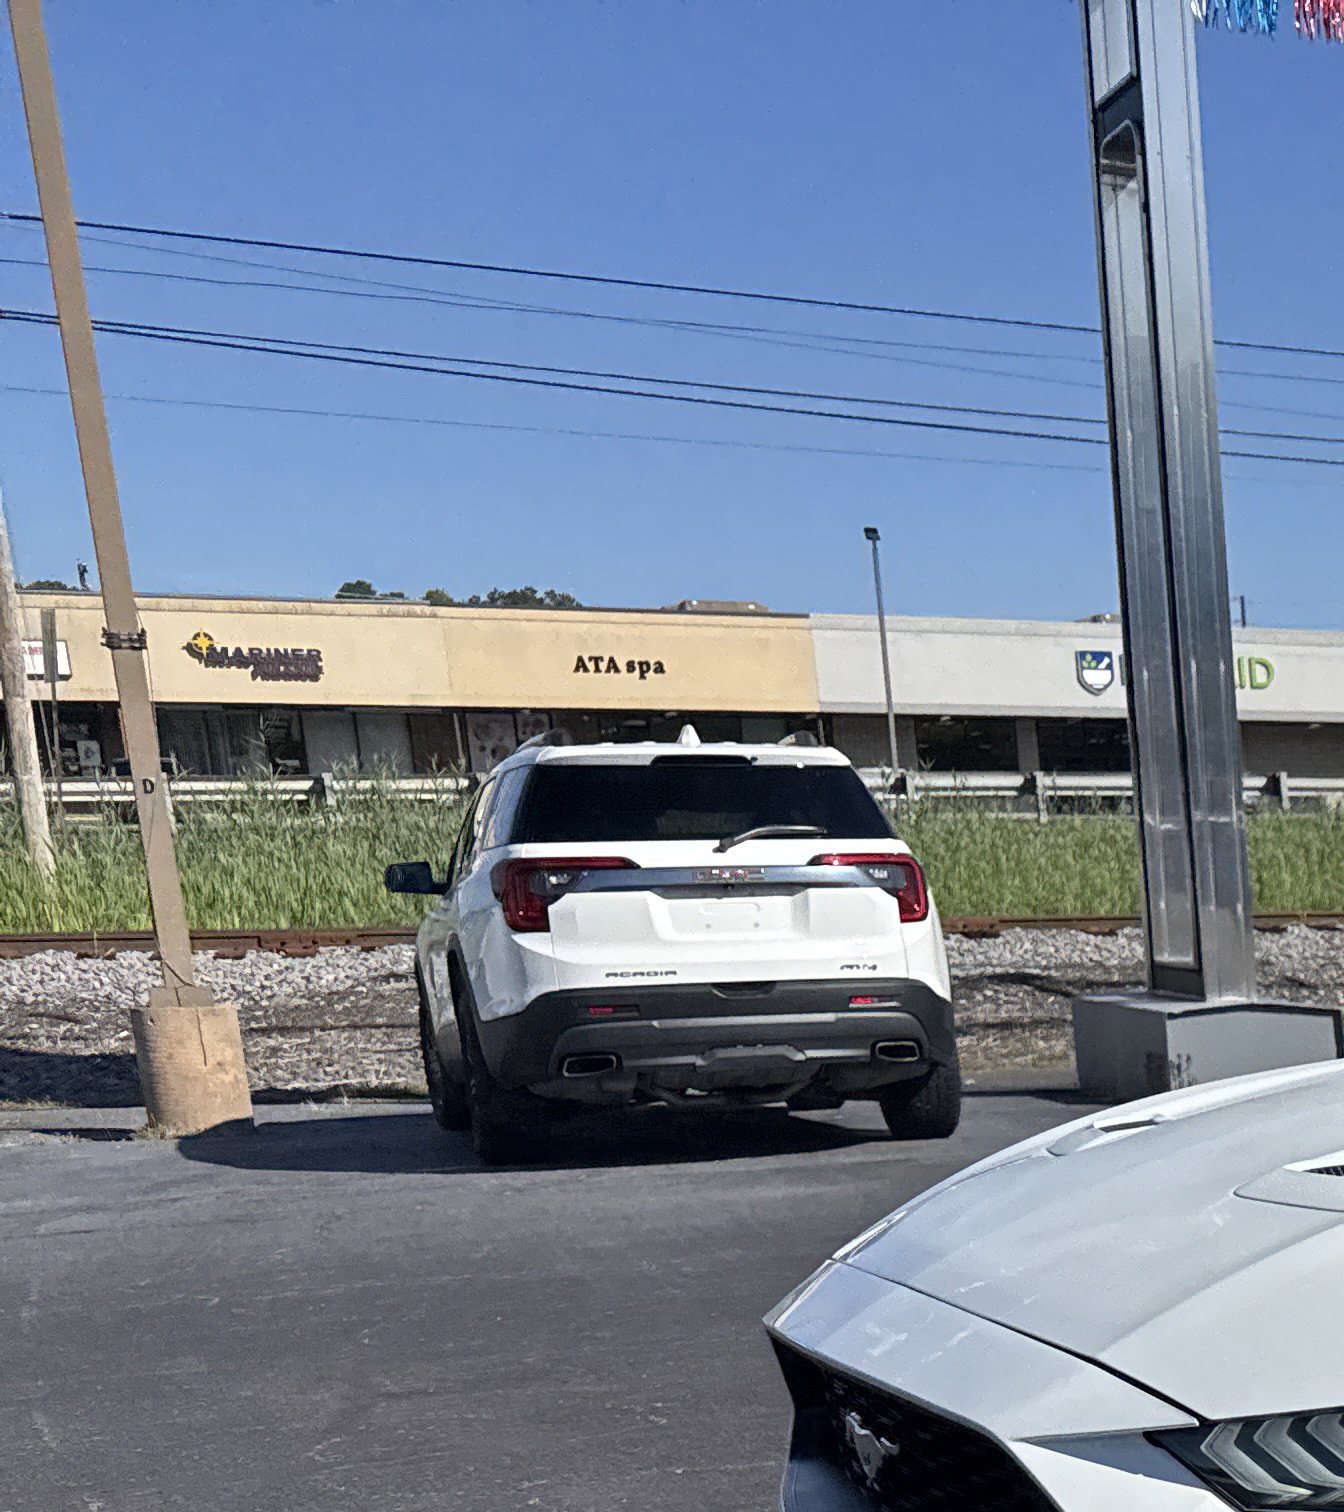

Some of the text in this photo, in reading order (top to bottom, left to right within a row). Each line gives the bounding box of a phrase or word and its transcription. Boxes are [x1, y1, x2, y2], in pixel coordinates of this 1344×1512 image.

[573, 655, 666, 680] ATA spa
[1235, 655, 1275, 689] ID
